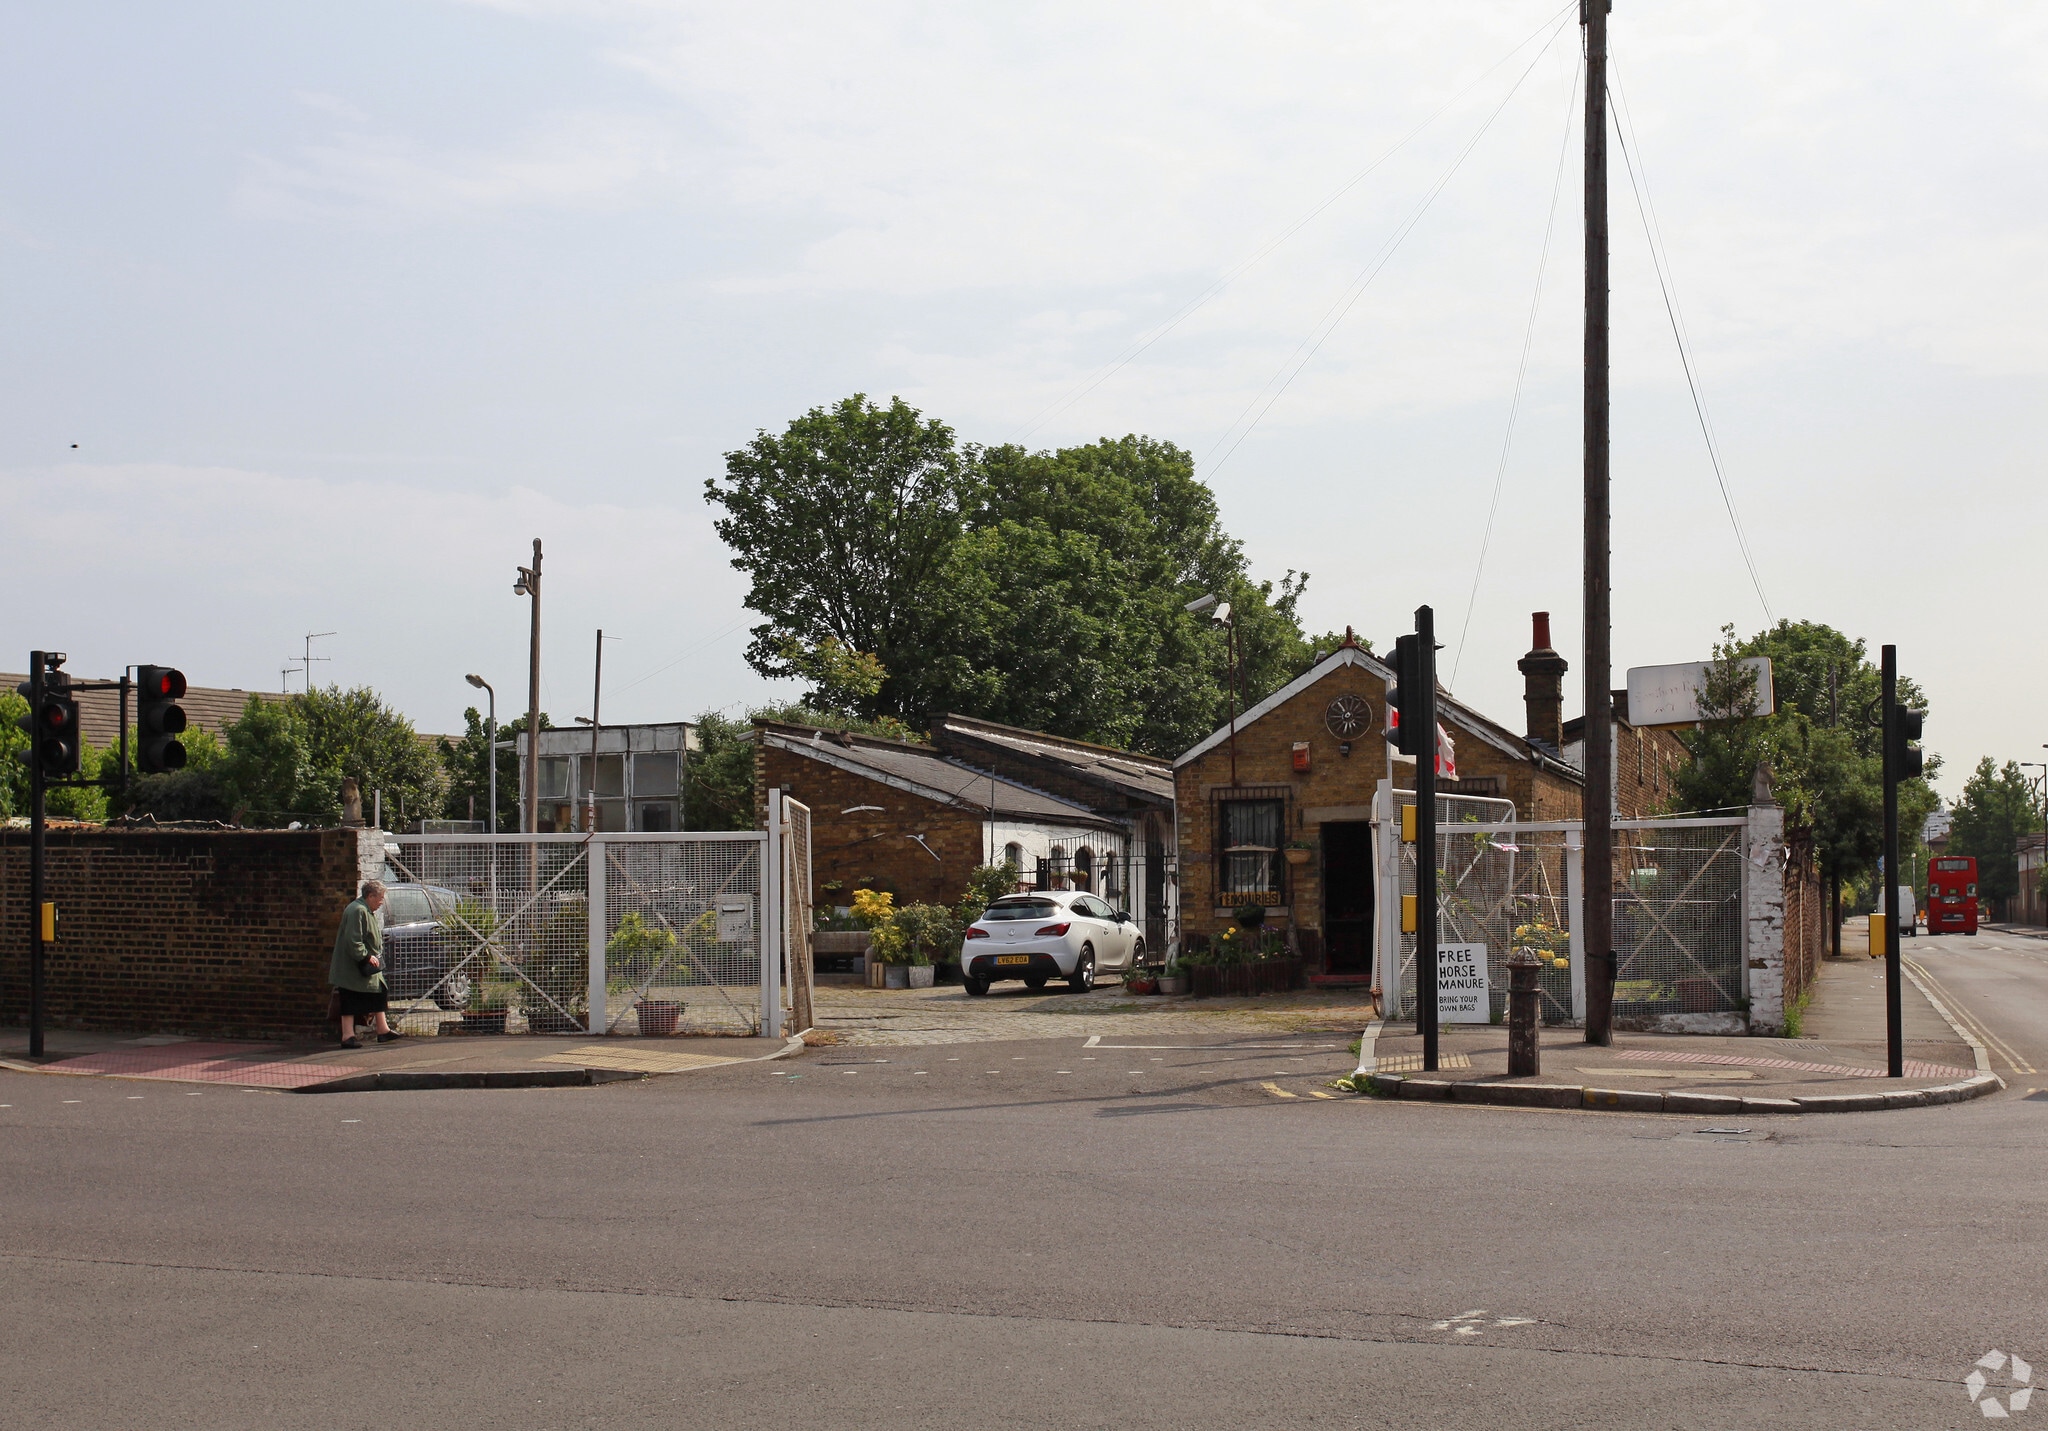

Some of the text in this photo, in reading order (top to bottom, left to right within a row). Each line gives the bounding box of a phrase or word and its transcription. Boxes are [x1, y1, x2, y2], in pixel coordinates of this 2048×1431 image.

[1438, 949, 1472, 963] FREE
[1439, 965, 1476, 978] HORSE
[1438, 978, 1484, 990] MANURE
[1438, 995, 1478, 1004] BRING YOUR
[1439, 1003, 1476, 1012] OWN BAGS
